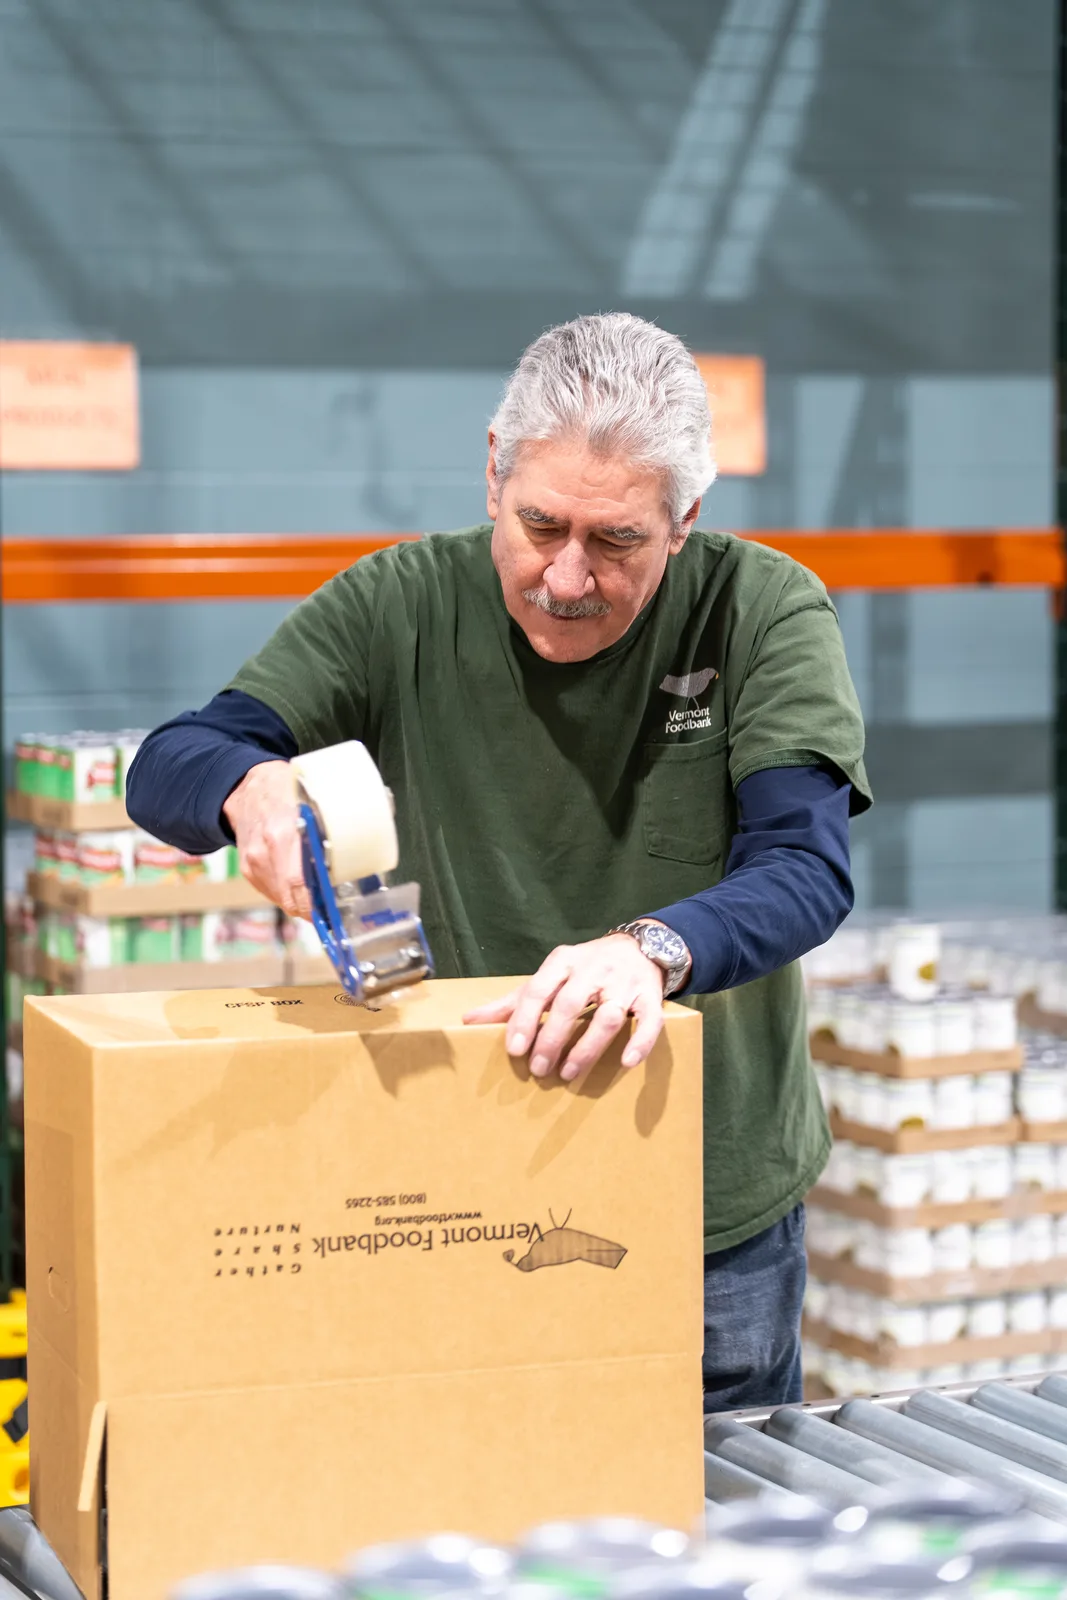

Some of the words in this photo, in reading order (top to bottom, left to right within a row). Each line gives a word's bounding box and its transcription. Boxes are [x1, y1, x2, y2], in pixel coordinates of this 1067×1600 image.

[668, 706, 710, 722] Vermont
[665, 716, 712, 734] Foodbank
[345, 1195, 396, 1209] 585-2265
[398, 1192, 427, 1206] (800)
[374, 1210, 482, 1226] www.vtfoodbank.org
[213, 1223, 300, 1237] Nurture
[440, 1221, 545, 1248] Vermont
[214, 1243, 301, 1257] Share
[312, 1229, 433, 1258] Foodbank
[214, 1263, 302, 1278] Gather
